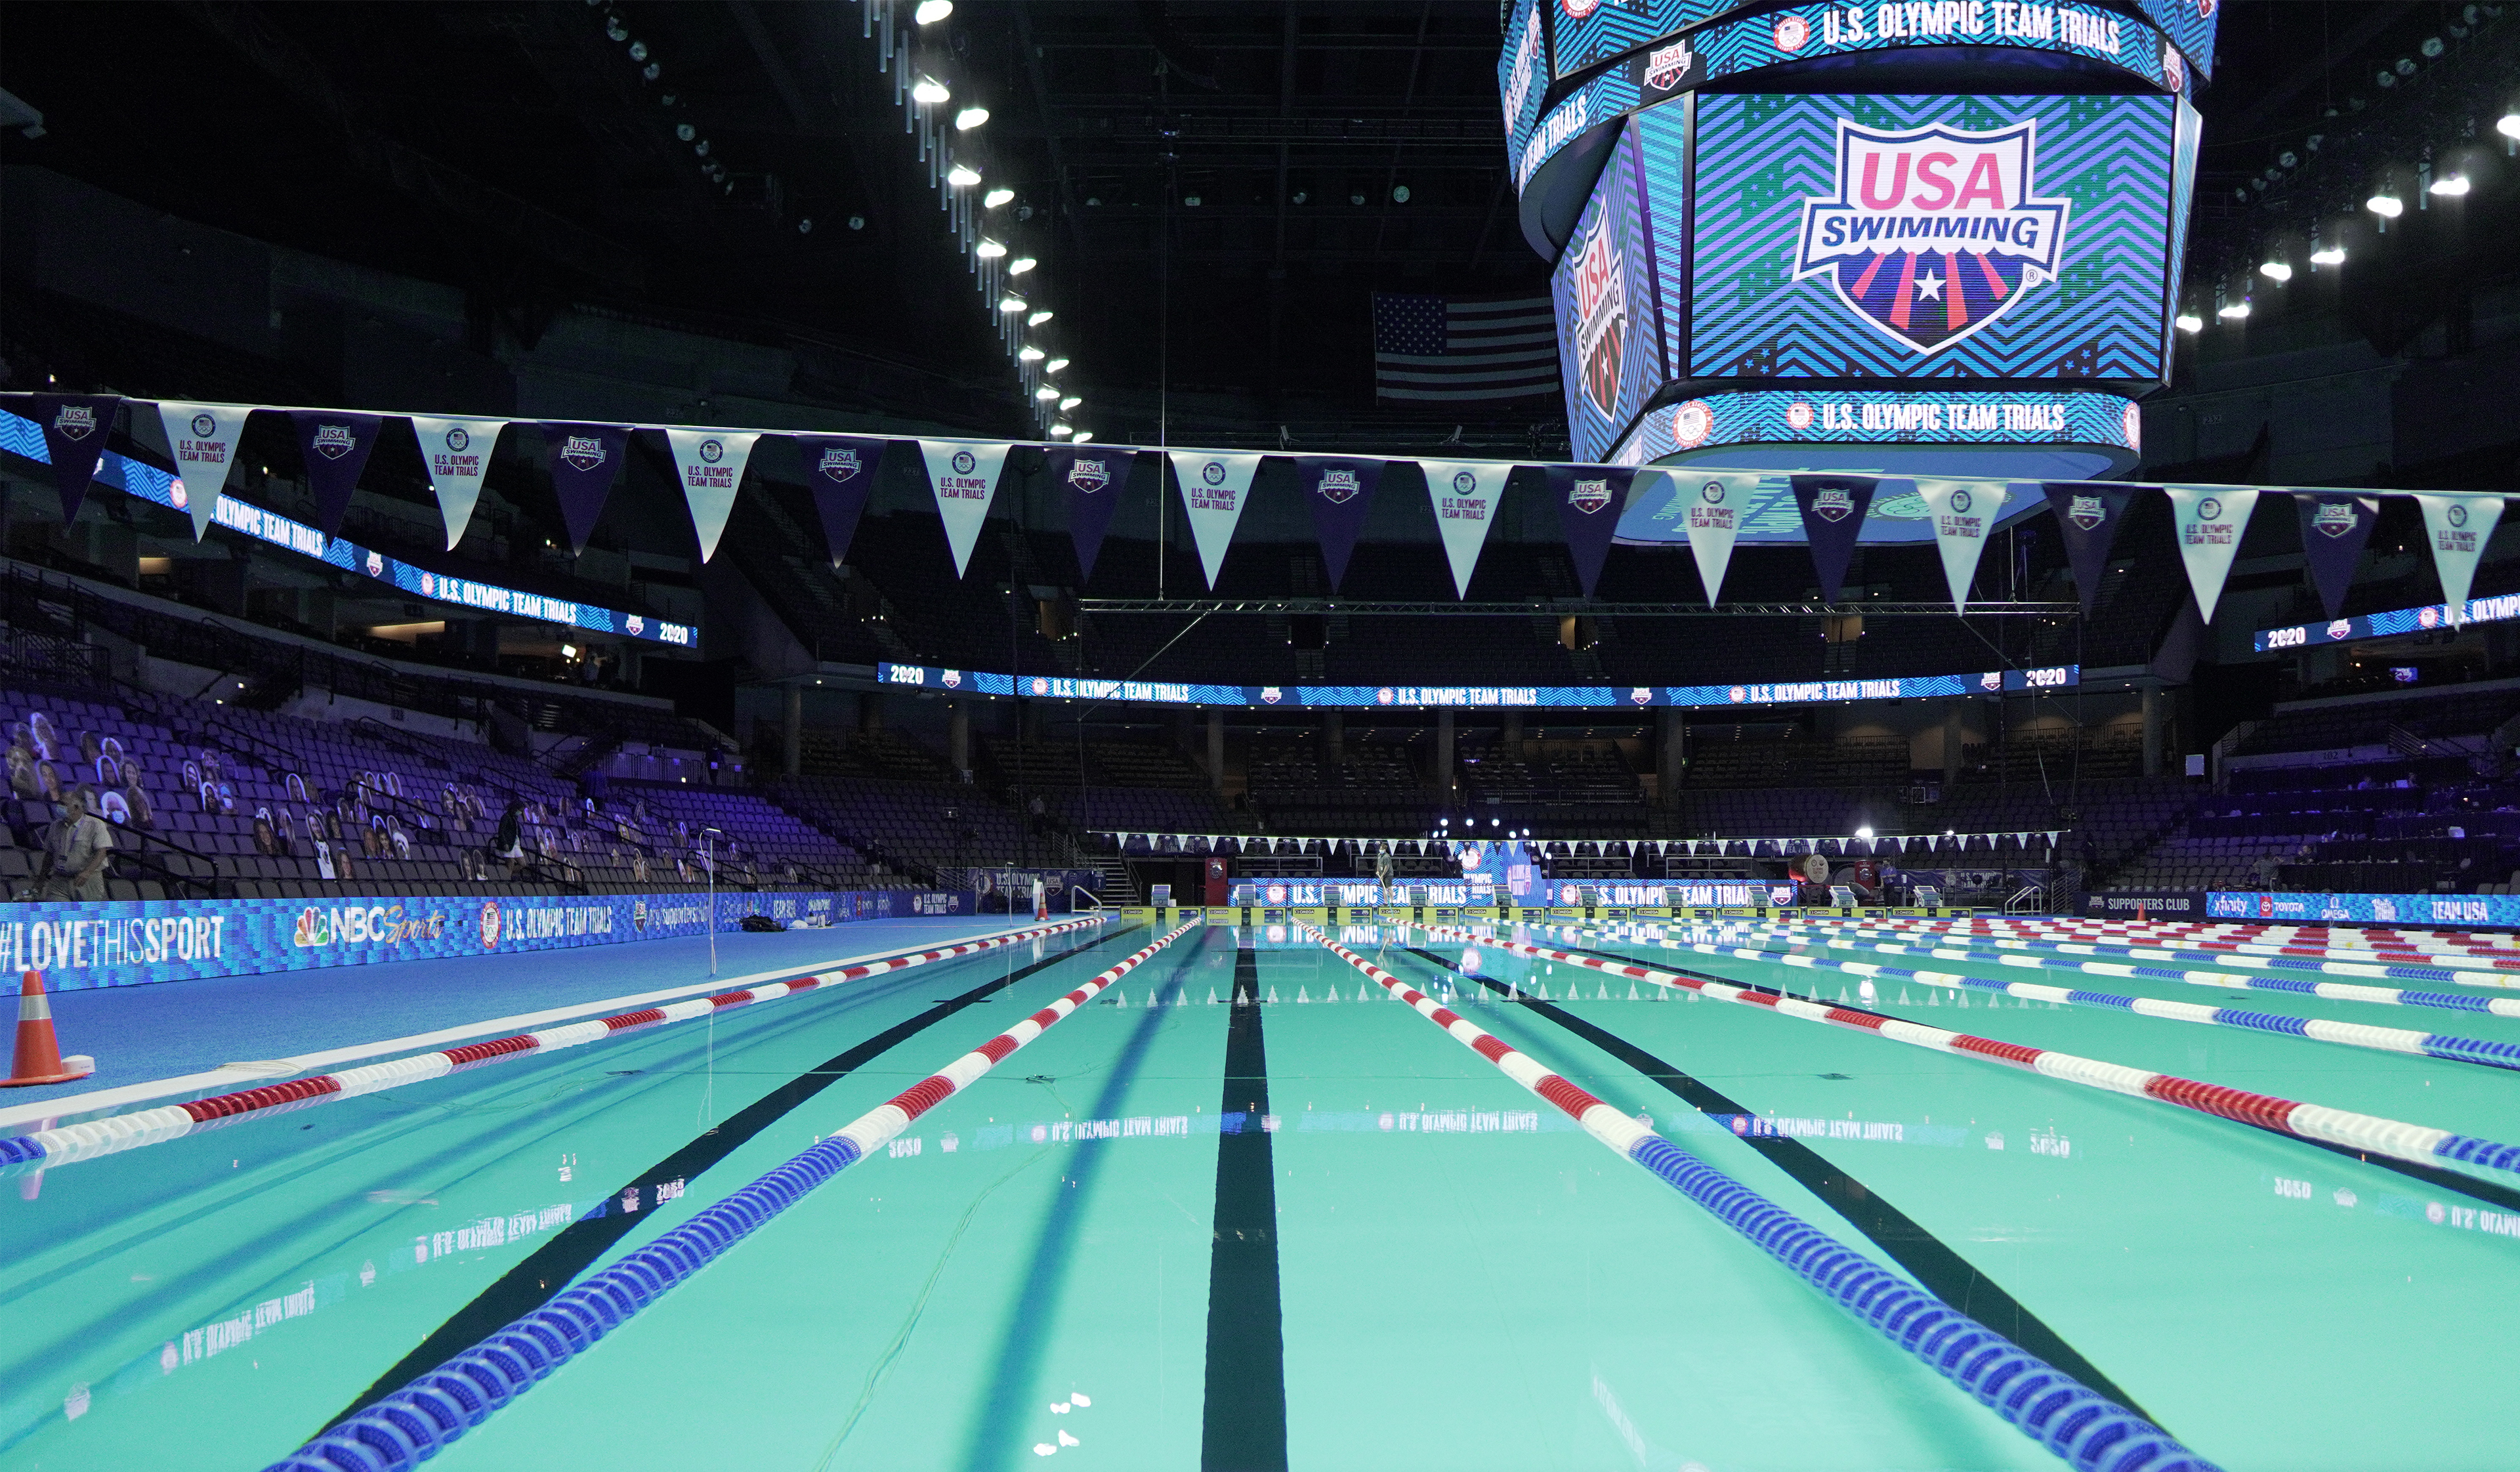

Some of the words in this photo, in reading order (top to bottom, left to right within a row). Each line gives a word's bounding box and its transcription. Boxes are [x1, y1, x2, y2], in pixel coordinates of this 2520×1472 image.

[1824, 7, 1872, 45] U.S.
[1878, 0, 1984, 38] OLYMPIC
[1992, 1, 2053, 39] TEAM
[2058, 8, 2120, 54] TRIALS
[1655, 49, 1679, 66] USA
[1648, 58, 1687, 77] SWIMMING
[1526, 126, 1546, 175] TEAM
[1547, 95, 1586, 150] TRIALS
[1860, 152, 2006, 211] USA
[1822, 216, 2040, 249] SWIMMING
[1580, 238, 1609, 320] USA
[1581, 278, 1620, 360] SWIMMING
[66, 410, 88, 419] USA
[1823, 404, 1858, 430] U.S.
[1862, 404, 1941, 430] OLYMPIC
[1946, 404, 1996, 431] TEAM
[2002, 404, 2065, 431] TRIALS
[322, 429, 345, 438] USA
[180, 440, 194, 450] U.S.
[196, 440, 226, 453] OLYMPIC
[572, 440, 596, 451] USA
[180, 451, 199, 461] TEAM
[201, 452, 224, 463] TRIALS
[434, 454, 448, 465] U.S.
[451, 455, 479, 465] OLYMPIC
[829, 453, 852, 461] USA
[434, 465, 454, 475] TEAM
[456, 466, 478, 476] TRIALS
[688, 465, 702, 476] U.S.
[704, 467, 732, 477] OLYMPIC
[1078, 463, 1101, 473] USA
[688, 476, 707, 486] TEAM
[709, 478, 732, 488] TRIALS
[940, 477, 954, 487] U.S.
[956, 478, 986, 489] OLYMPIC
[1328, 474, 1350, 482] USA
[940, 488, 959, 498] TEAM
[961, 489, 984, 499] TRIALS
[1191, 488, 1204, 498] U.S.
[1207, 488, 1236, 500] OLYMPIC
[1822, 493, 1845, 501] USA
[1191, 499, 1209, 509] TEAM
[1212, 499, 1234, 511] TRIALS
[1442, 497, 1454, 508] U.S.
[1457, 499, 1486, 509] OLYMPIC
[1441, 509, 1460, 518] TEAM
[1462, 509, 1484, 520] TRIALS
[1690, 507, 1704, 517] U.S.
[1707, 507, 1733, 518] OLYMPIC
[217, 495, 261, 536] OLYMPIC
[262, 512, 291, 545] TEAM
[291, 522, 323, 557] TRIALS
[1690, 518, 1710, 528] TEAM
[1712, 518, 1732, 529] TRIALS
[440, 577, 461, 602] U.S.
[463, 581, 511, 611] OLYMPIC
[513, 592, 541, 617] TEAM
[543, 599, 577, 624] TRIALS
[660, 623, 688, 644] 2020
[2268, 627, 2306, 648] 2020
[890, 664, 925, 684] 2020
[2026, 668, 2067, 687] 2020
[1053, 679, 1075, 698] U.S.
[1078, 680, 1121, 700] OLYMPIC
[1123, 683, 1153, 701] TEAM
[1154, 684, 1189, 702] TRIALS
[1398, 688, 1419, 704] U.S.
[1421, 688, 1467, 705] OLYMPIC
[1469, 688, 1499, 705] TEAM
[1500, 688, 1538, 705] TRIALS
[1750, 684, 1773, 703] U.S.
[1774, 683, 1822, 702] OLYMPIC
[1825, 681, 1858, 700] TEAM
[1860, 680, 1900, 699] TRIALS
[932, 893, 947, 904] OLYMPIC
[1293, 886, 1318, 904] U.S.
[1429, 886, 1467, 904] RIALS
[1616, 886, 1663, 904] OLYMPI
[923, 904, 934, 914] TEAM
[934, 904, 947, 915] TRIALS
[2108, 898, 2164, 911] SUPPORTERS
[2166, 898, 2190, 912] CLUB
[2214, 894, 2248, 916] xfinity
[2274, 901, 2305, 912] TOYOTA
[2431, 901, 2461, 920] TEAM
[2463, 901, 2490, 921] USA
[2320, 908, 2350, 919] OMEGA
[331, 906, 385, 943] NBC
[383, 904, 446, 950] Sports
[506, 908, 525, 940] U.S.
[527, 907, 564, 938] OLYMPIC
[565, 907, 587, 936] TEAM
[588, 905, 612, 935] TRIALS
[0, 916, 224, 973] #LOVETHISSPORT
